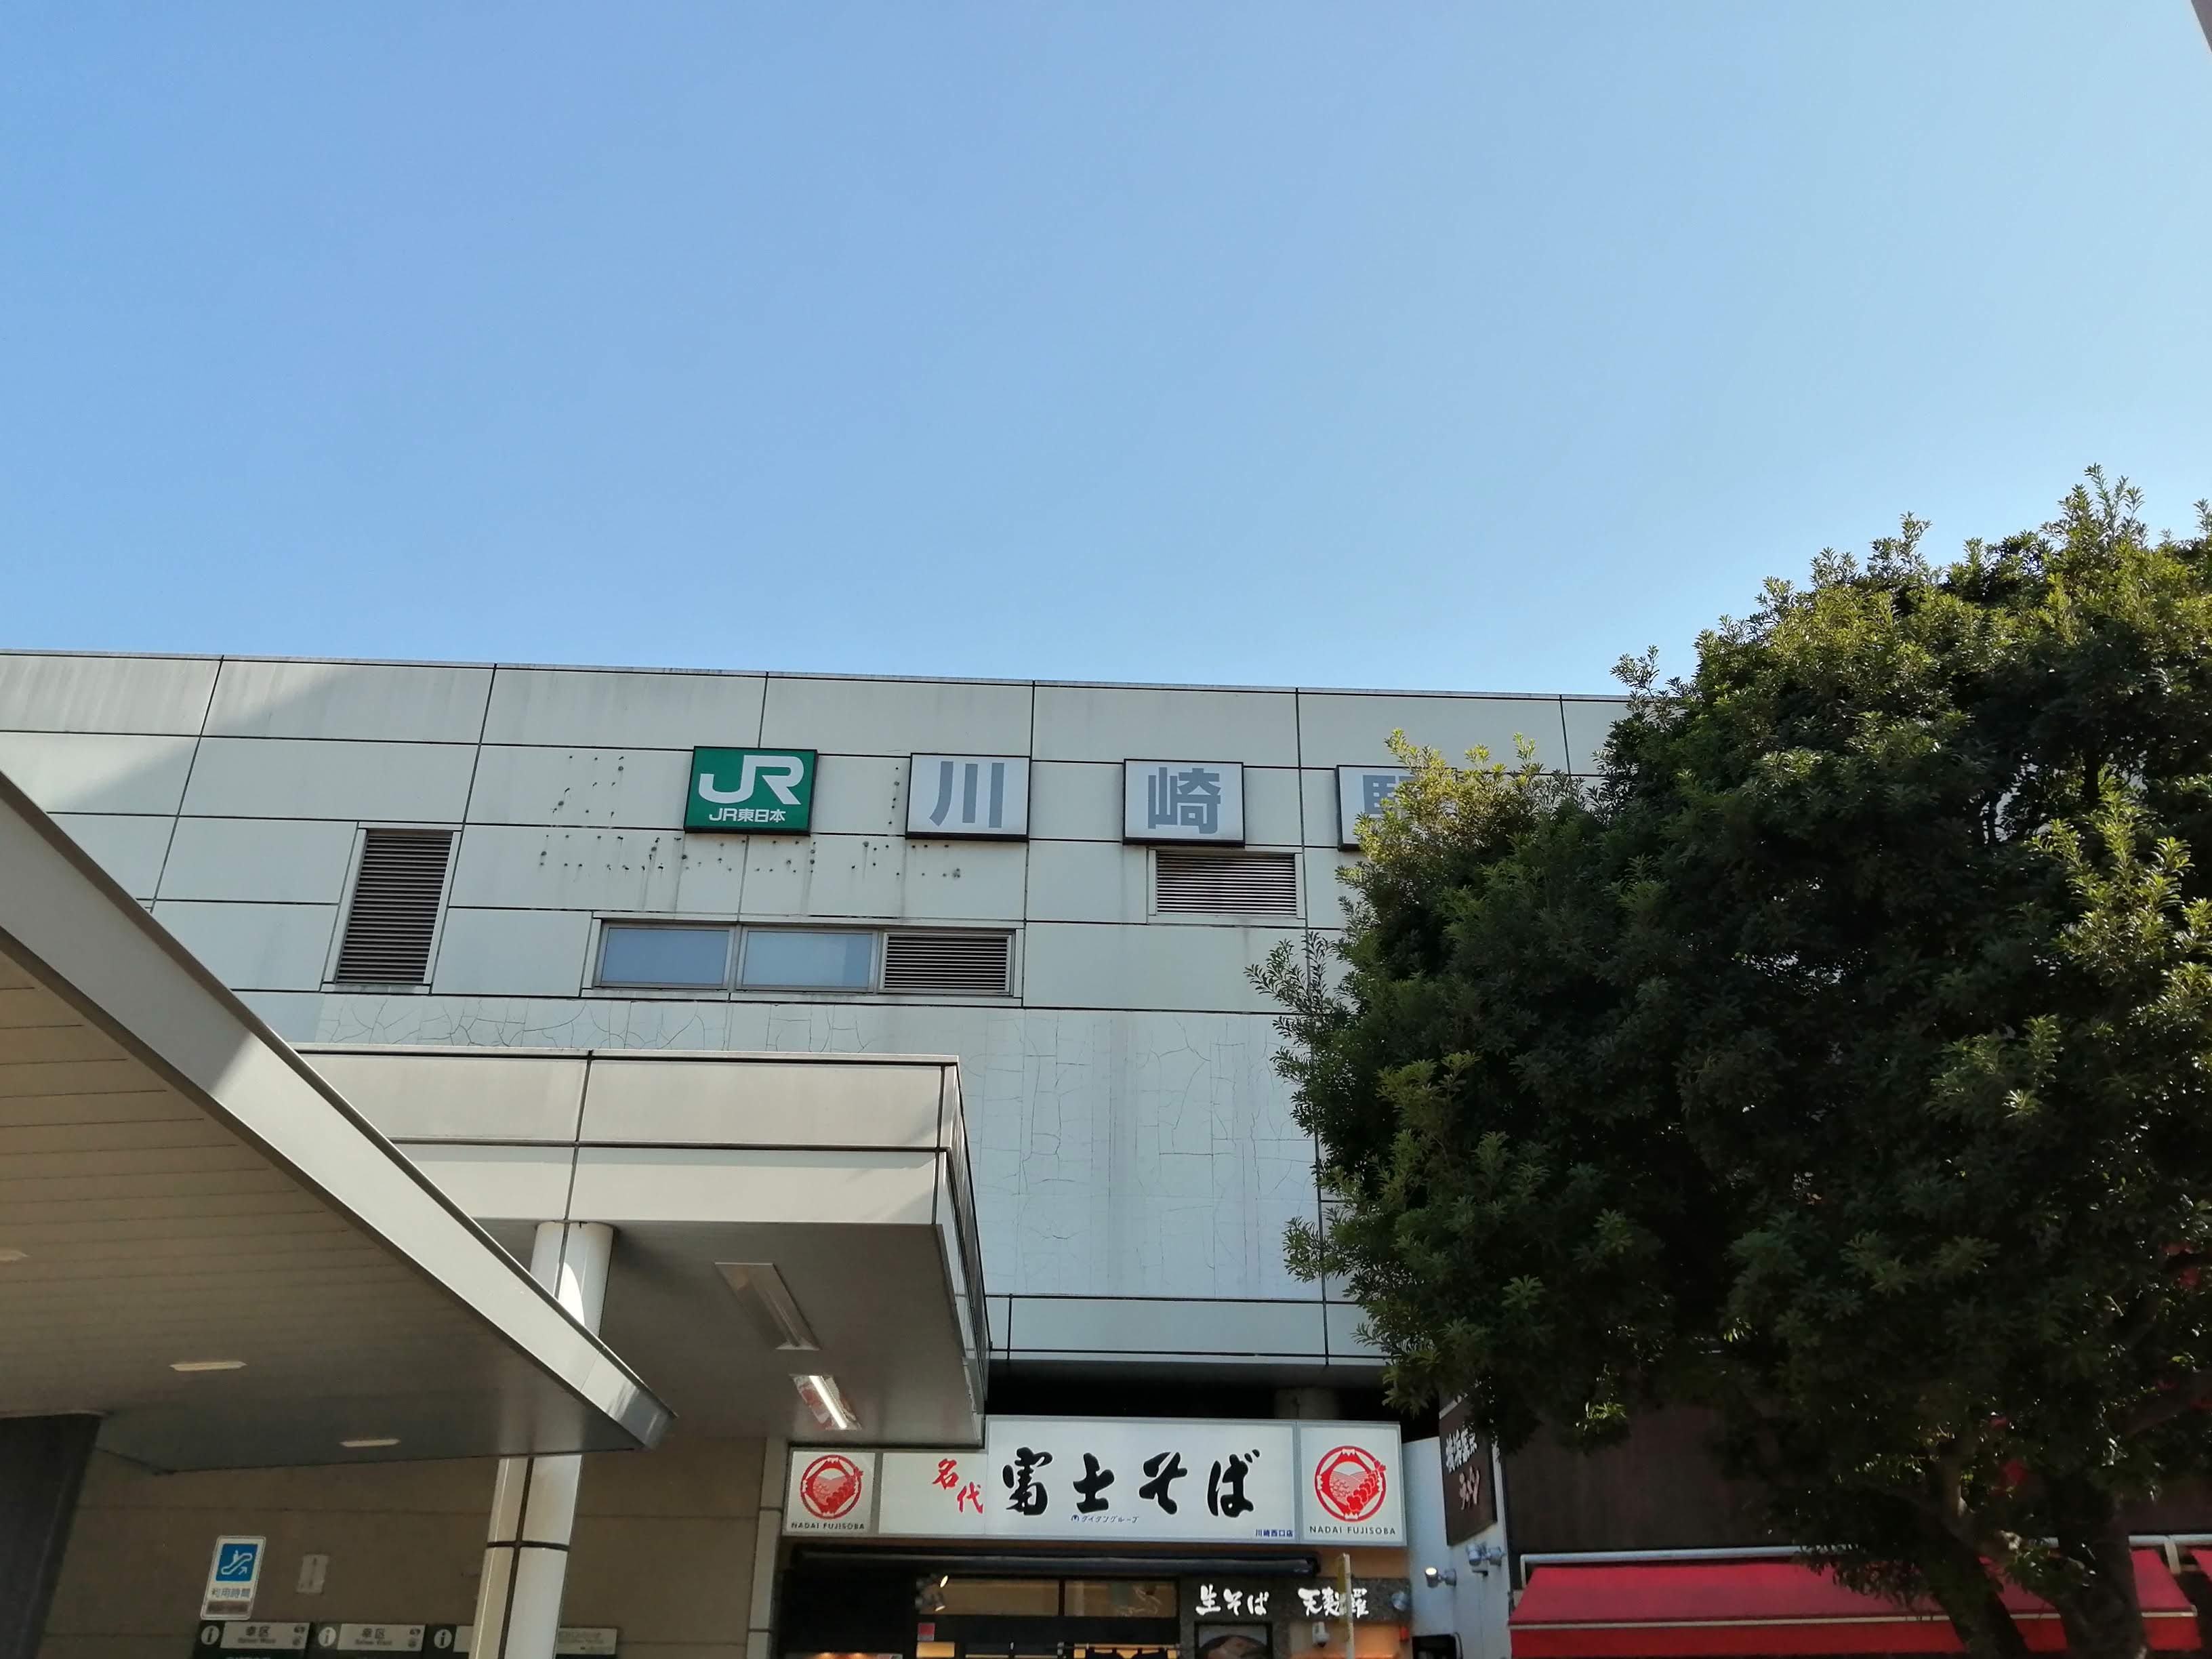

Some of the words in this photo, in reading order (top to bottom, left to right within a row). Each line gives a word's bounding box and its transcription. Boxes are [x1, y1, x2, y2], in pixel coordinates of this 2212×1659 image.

[698, 754, 804, 805] JR
[709, 808, 786, 823] JR東日本
[932, 1458, 984, 1514] 名代
[1002, 1447, 1261, 1517] 富士そば
[823, 1522, 865, 1530] FUJISOBA
[1255, 1528, 1294, 1538] 川崎西口店
[1309, 1525, 1343, 1534] NADAI
[1347, 1525, 1396, 1535] FUJISOBA
[1195, 1584, 1269, 1617] 生そば
